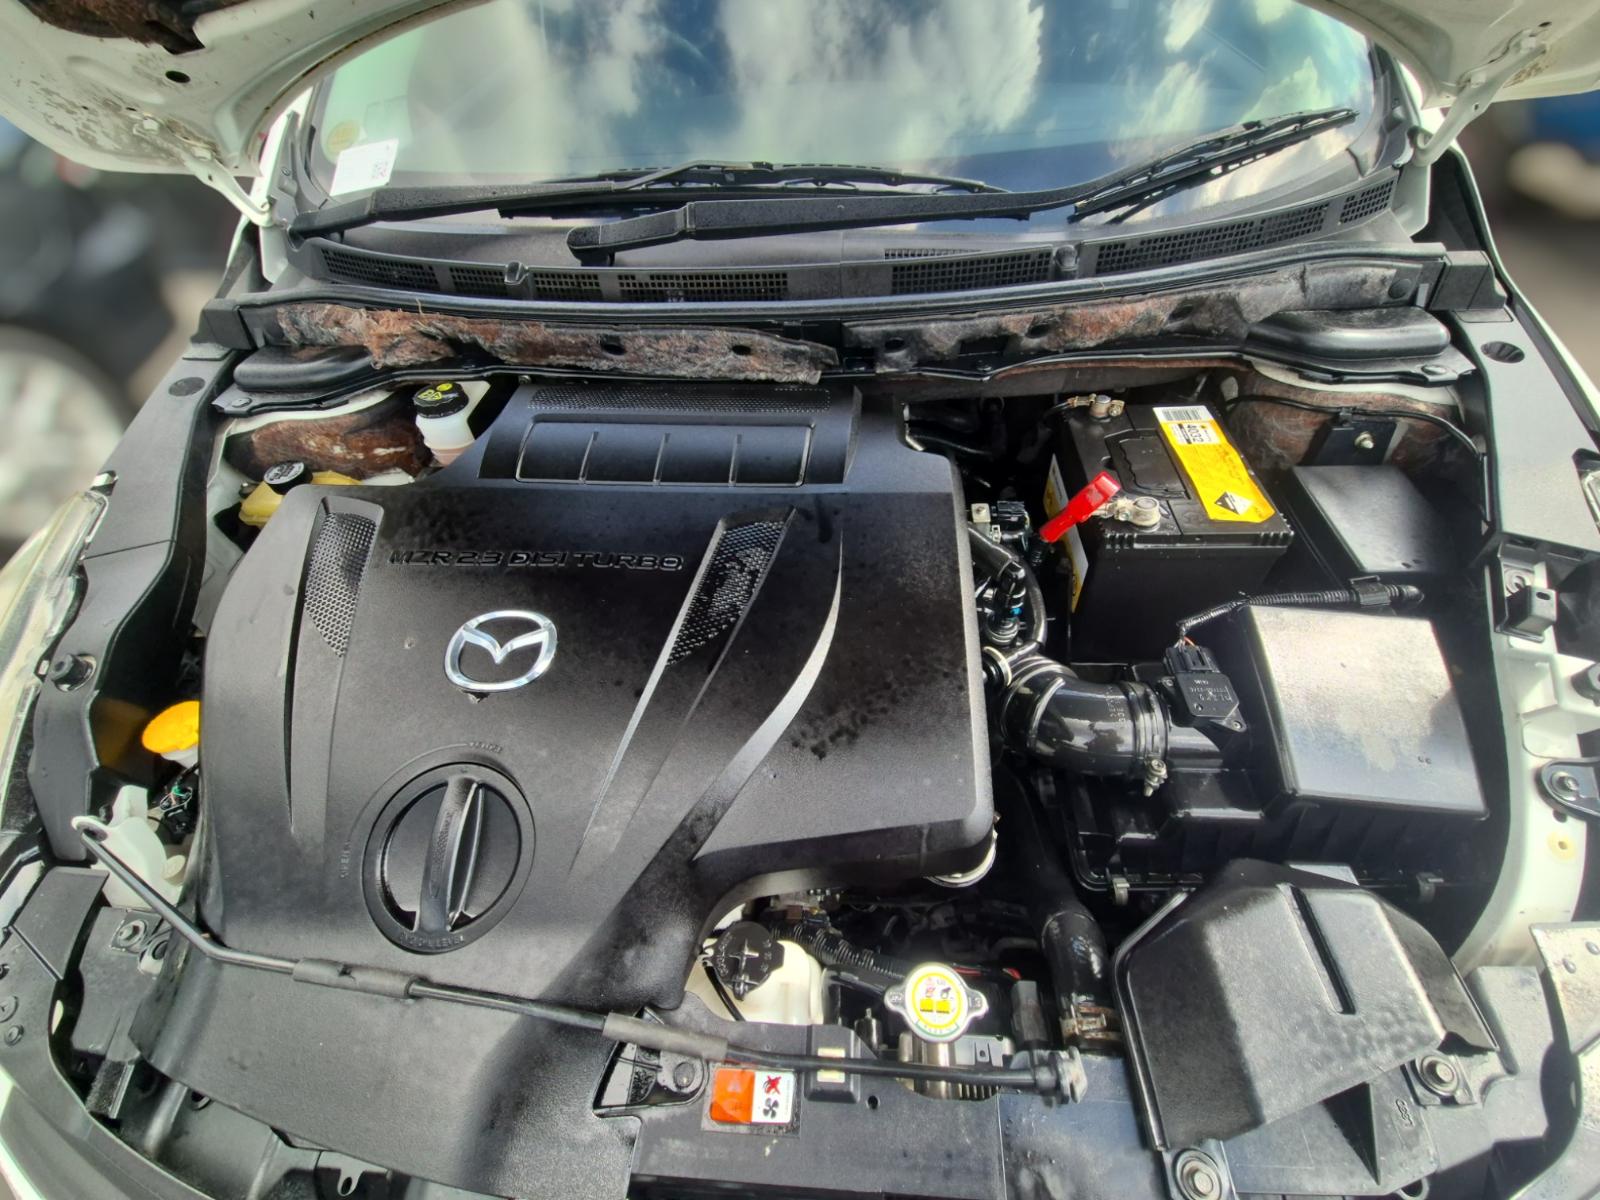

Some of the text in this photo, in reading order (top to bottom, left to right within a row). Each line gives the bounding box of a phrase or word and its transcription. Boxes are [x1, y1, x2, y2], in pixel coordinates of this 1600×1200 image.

[388, 550, 451, 566] MZR
[508, 551, 569, 567] DISI
[573, 552, 684, 571] TURBO
